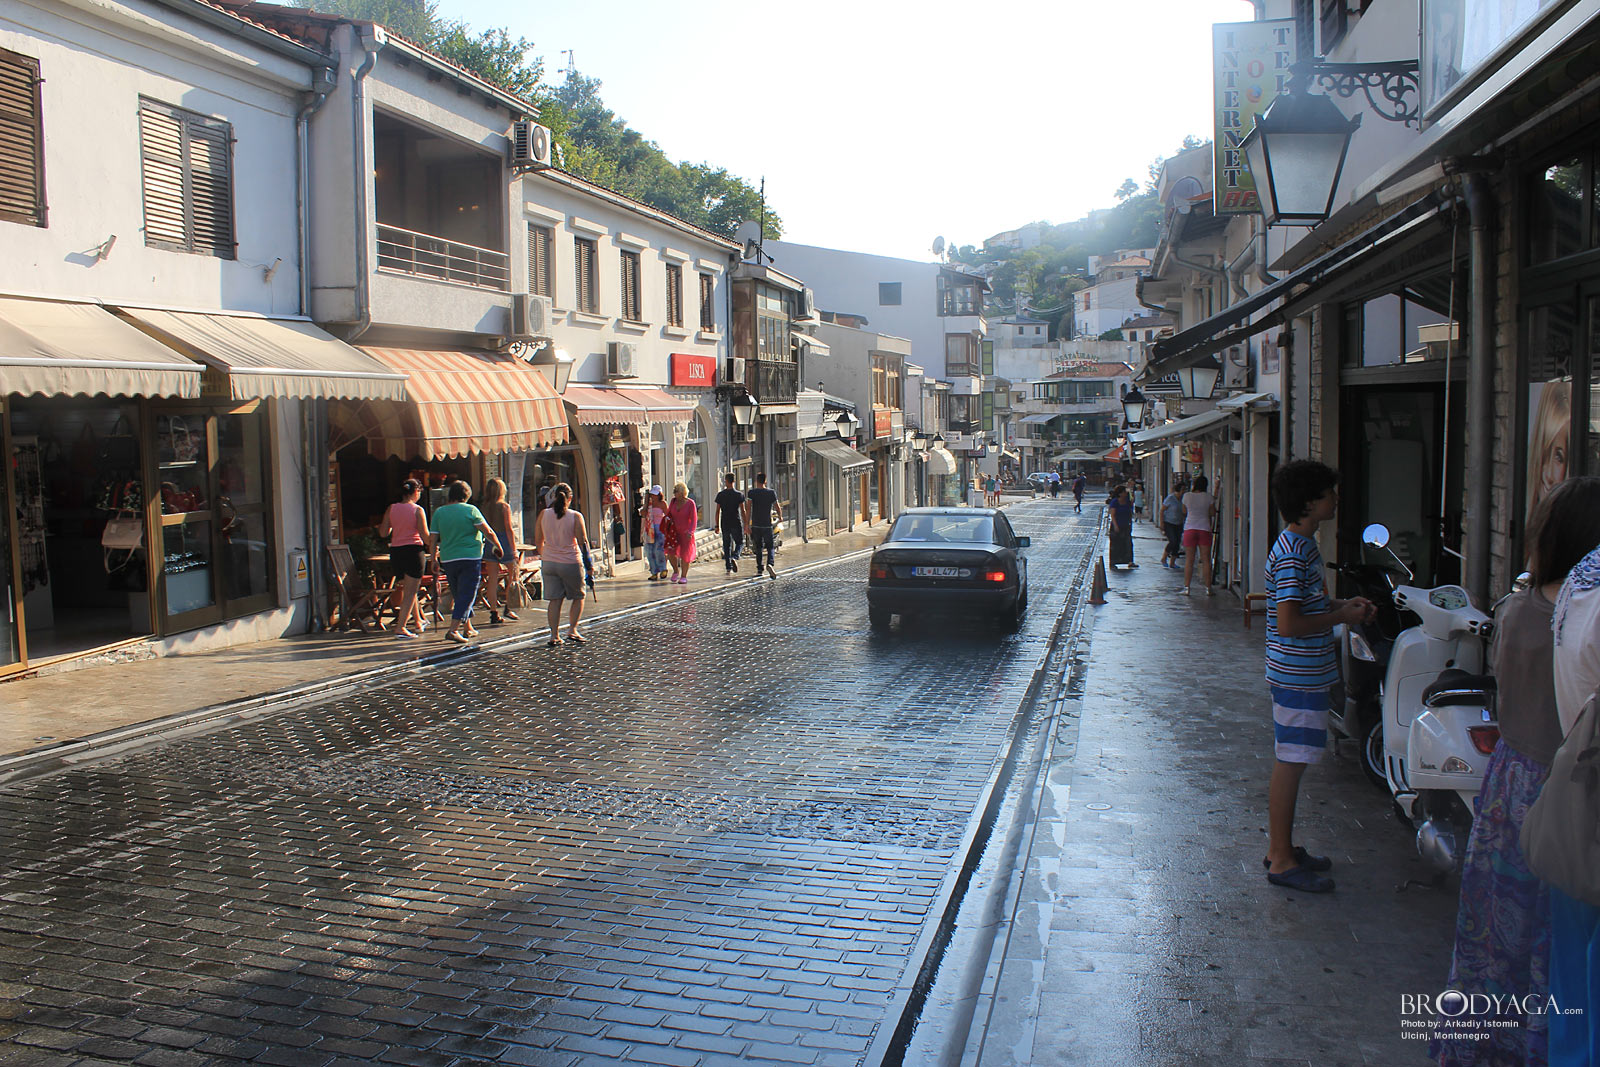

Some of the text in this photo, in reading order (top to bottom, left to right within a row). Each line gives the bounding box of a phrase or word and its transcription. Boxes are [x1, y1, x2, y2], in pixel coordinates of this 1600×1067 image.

[1222, 31, 1242, 187] INTERNET
[688, 363, 705, 378] LISCA
[916, 567, 927, 576] UL
